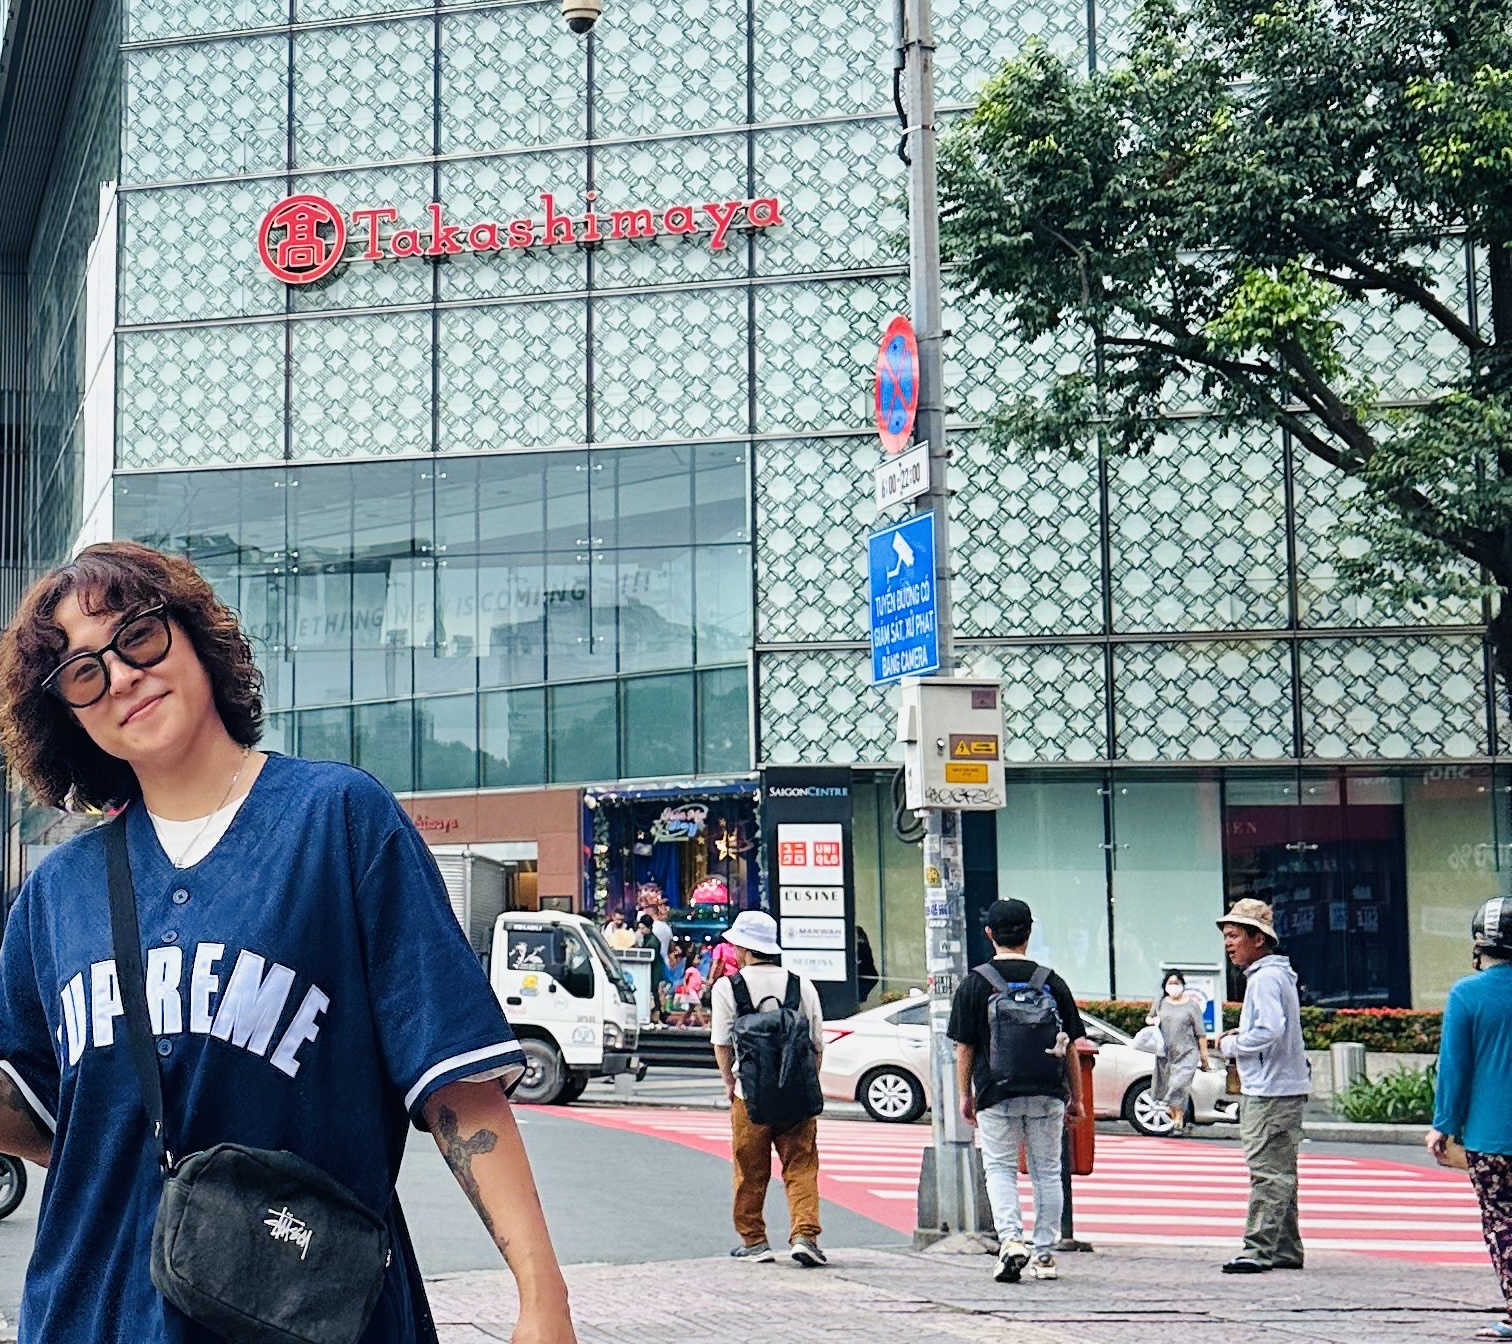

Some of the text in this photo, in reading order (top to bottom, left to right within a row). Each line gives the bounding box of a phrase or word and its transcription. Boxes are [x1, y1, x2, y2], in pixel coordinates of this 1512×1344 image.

[351, 191, 784, 259] Takashimaya
[900, 644, 929, 673] CAMERA
[56, 942, 331, 1078] UPREME
